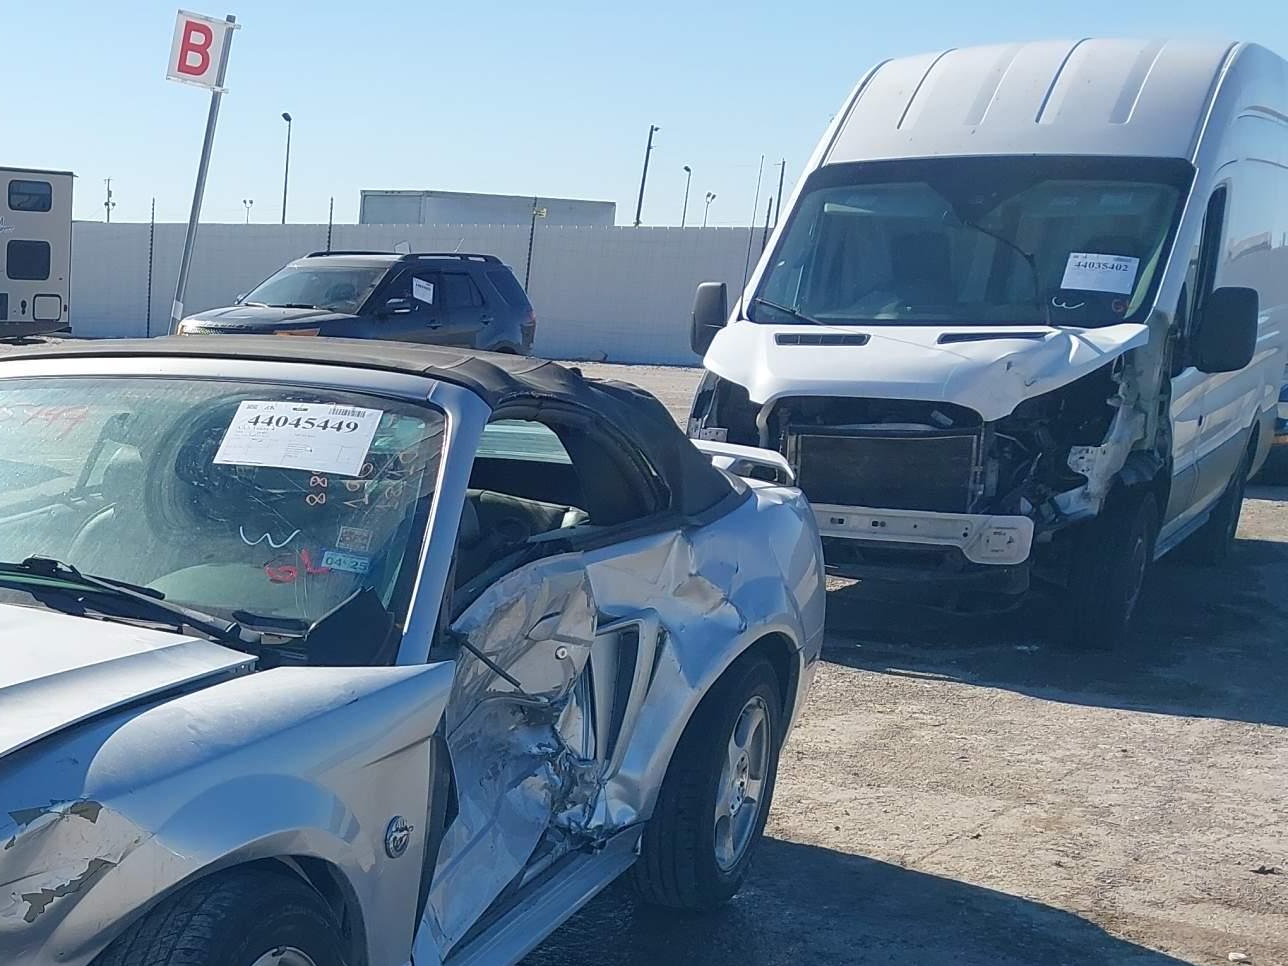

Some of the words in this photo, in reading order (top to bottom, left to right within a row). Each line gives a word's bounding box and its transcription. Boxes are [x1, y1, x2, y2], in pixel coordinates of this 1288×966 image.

[177, 20, 213, 76] B
[1073, 261, 1129, 272] 44035402
[247, 414, 359, 434] 44045449
[325, 556, 342, 567] 04
[349, 561, 368, 571] 25
